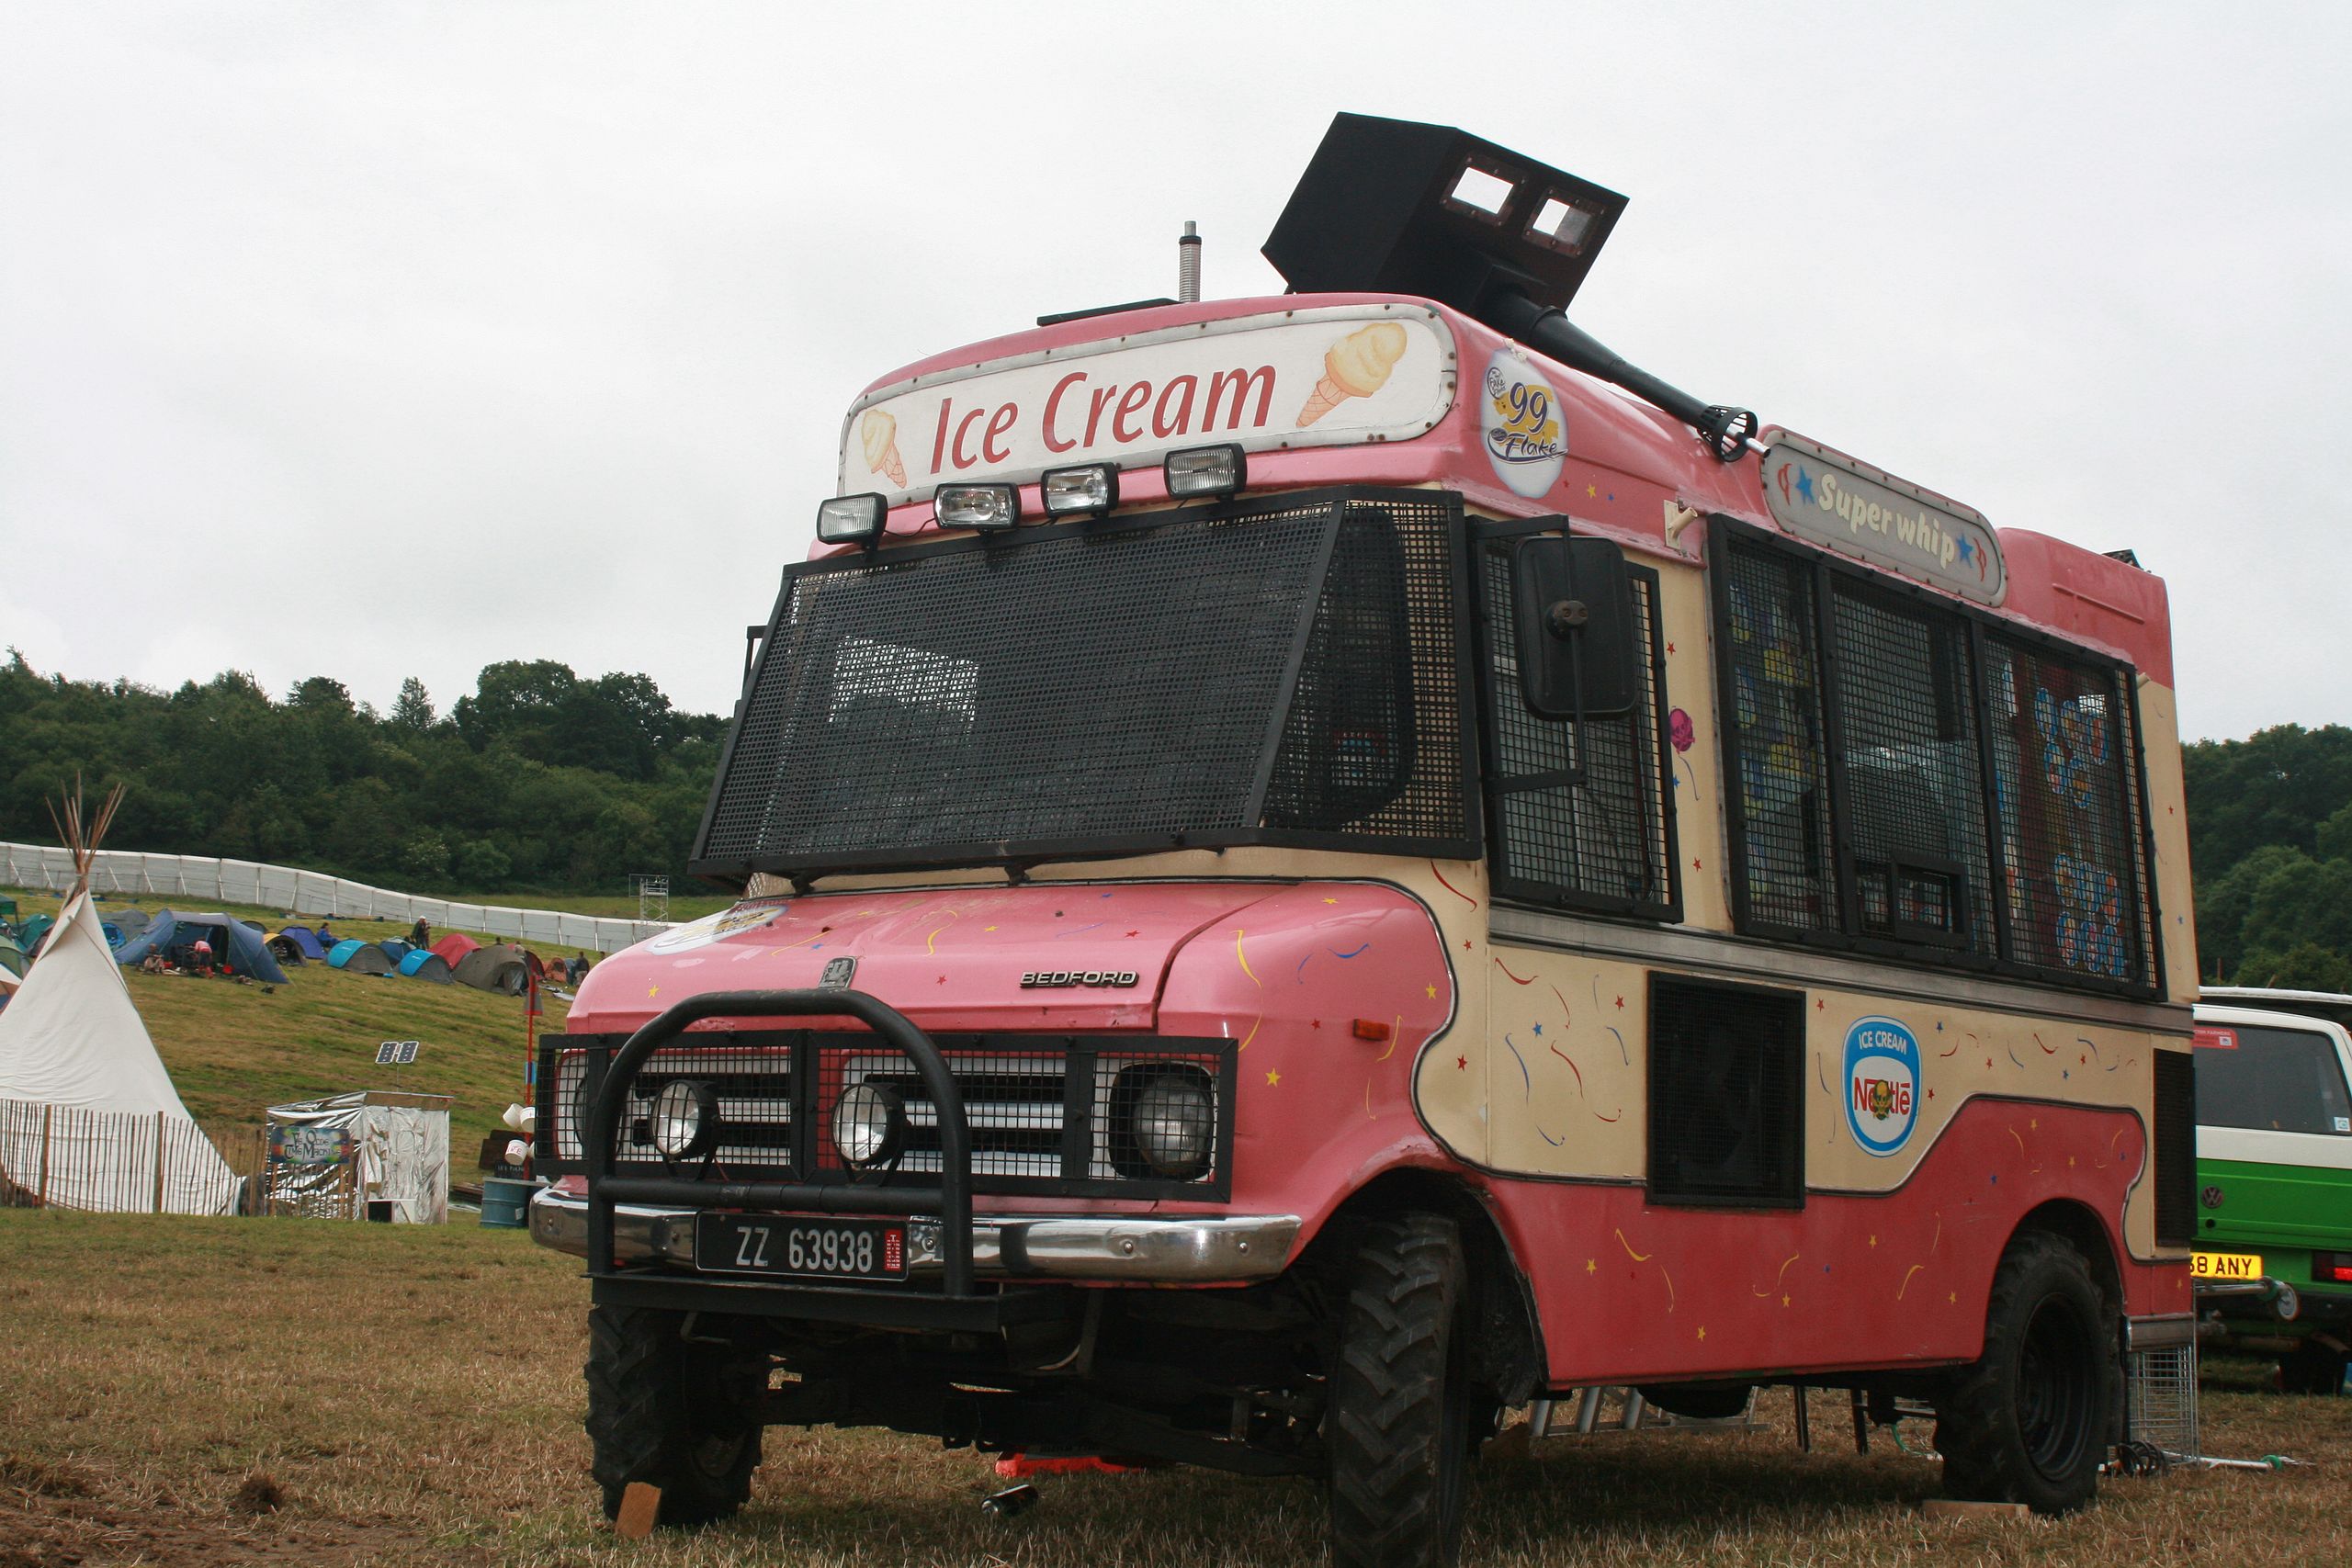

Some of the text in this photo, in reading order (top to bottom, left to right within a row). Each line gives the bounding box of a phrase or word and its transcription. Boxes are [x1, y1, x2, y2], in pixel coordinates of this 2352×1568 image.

[930, 366, 1276, 475] Ice Cream
[1508, 382, 1548, 434] 99
[1505, 432, 1564, 459] Flake
[1818, 473, 1955, 570] Super whip
[1020, 970, 1140, 989] BEDFORD
[1858, 1030, 1907, 1055] ICE CREAM
[736, 1226, 770, 1267] ZZ
[788, 1228, 873, 1273] 63938
[2215, 1256, 2253, 1276] ANY
